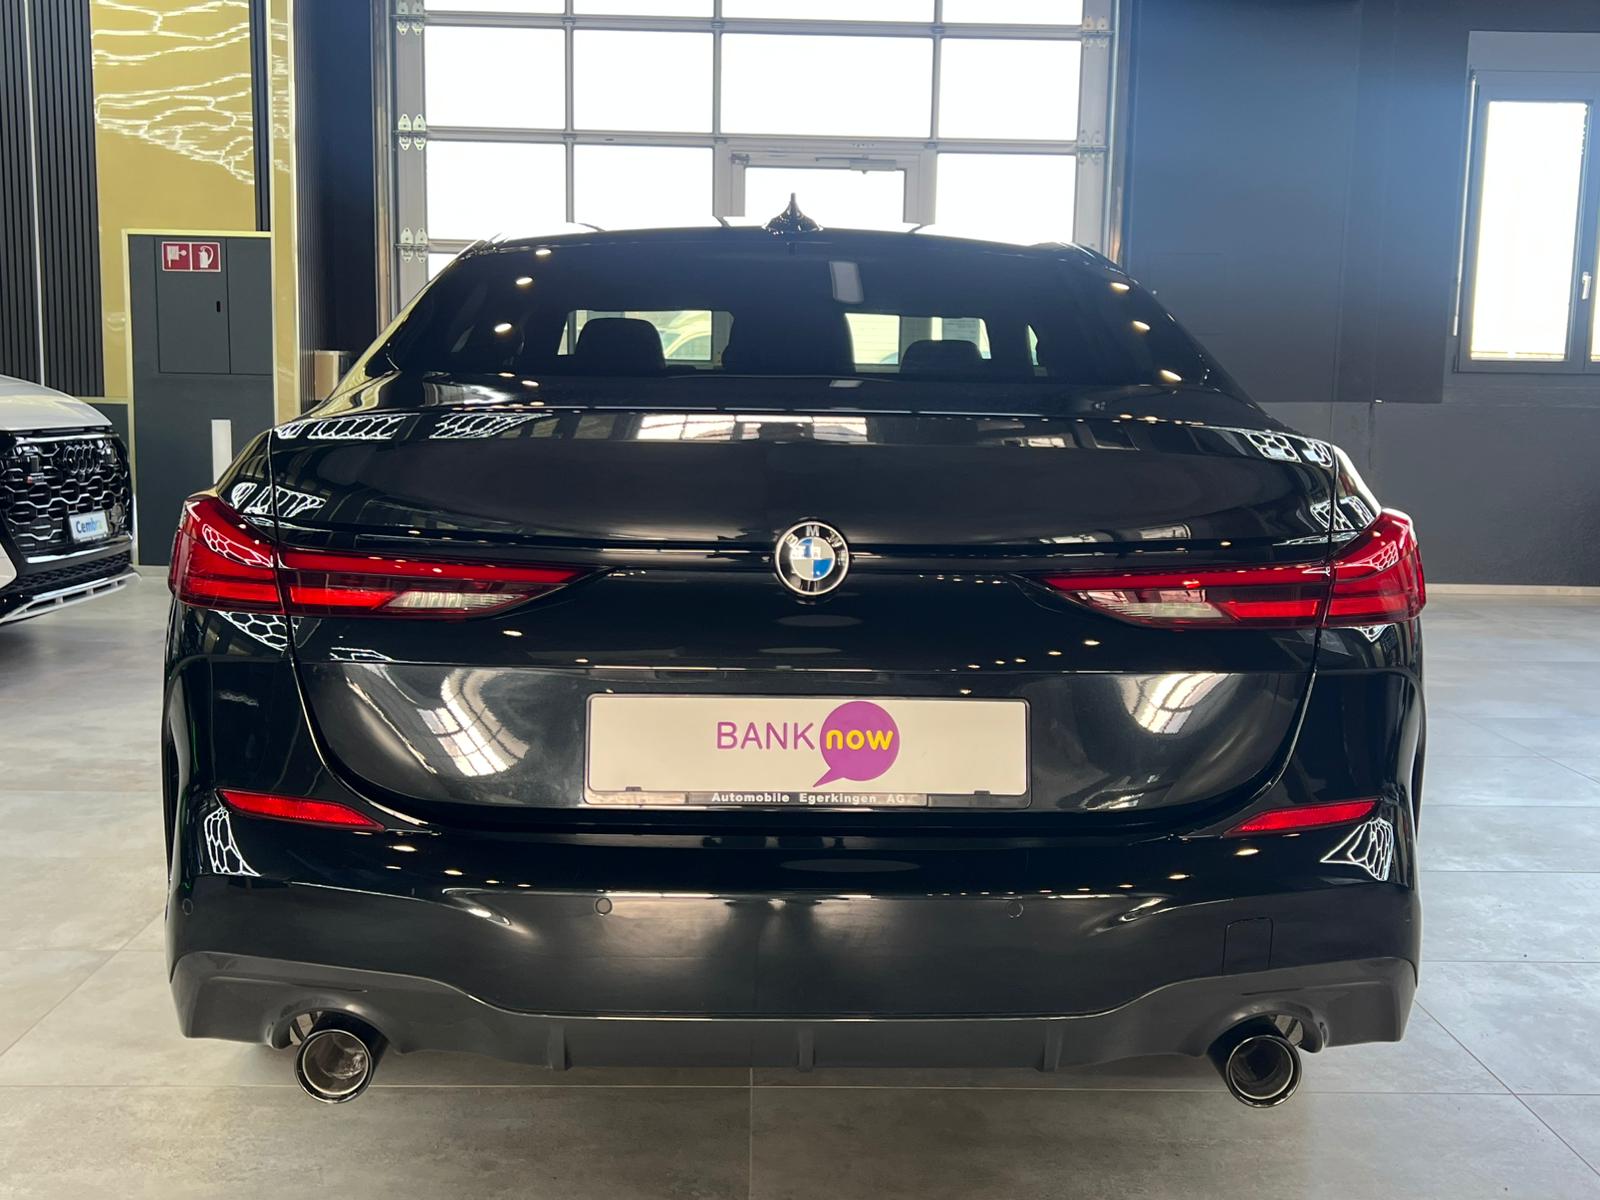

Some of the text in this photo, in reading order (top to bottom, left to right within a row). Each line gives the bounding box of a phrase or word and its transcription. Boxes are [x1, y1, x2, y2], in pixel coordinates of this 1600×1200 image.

[784, 525, 843, 549] BMW
[716, 721, 894, 750] BANK now
[711, 792, 905, 805] Automobile Egerkingen AG
